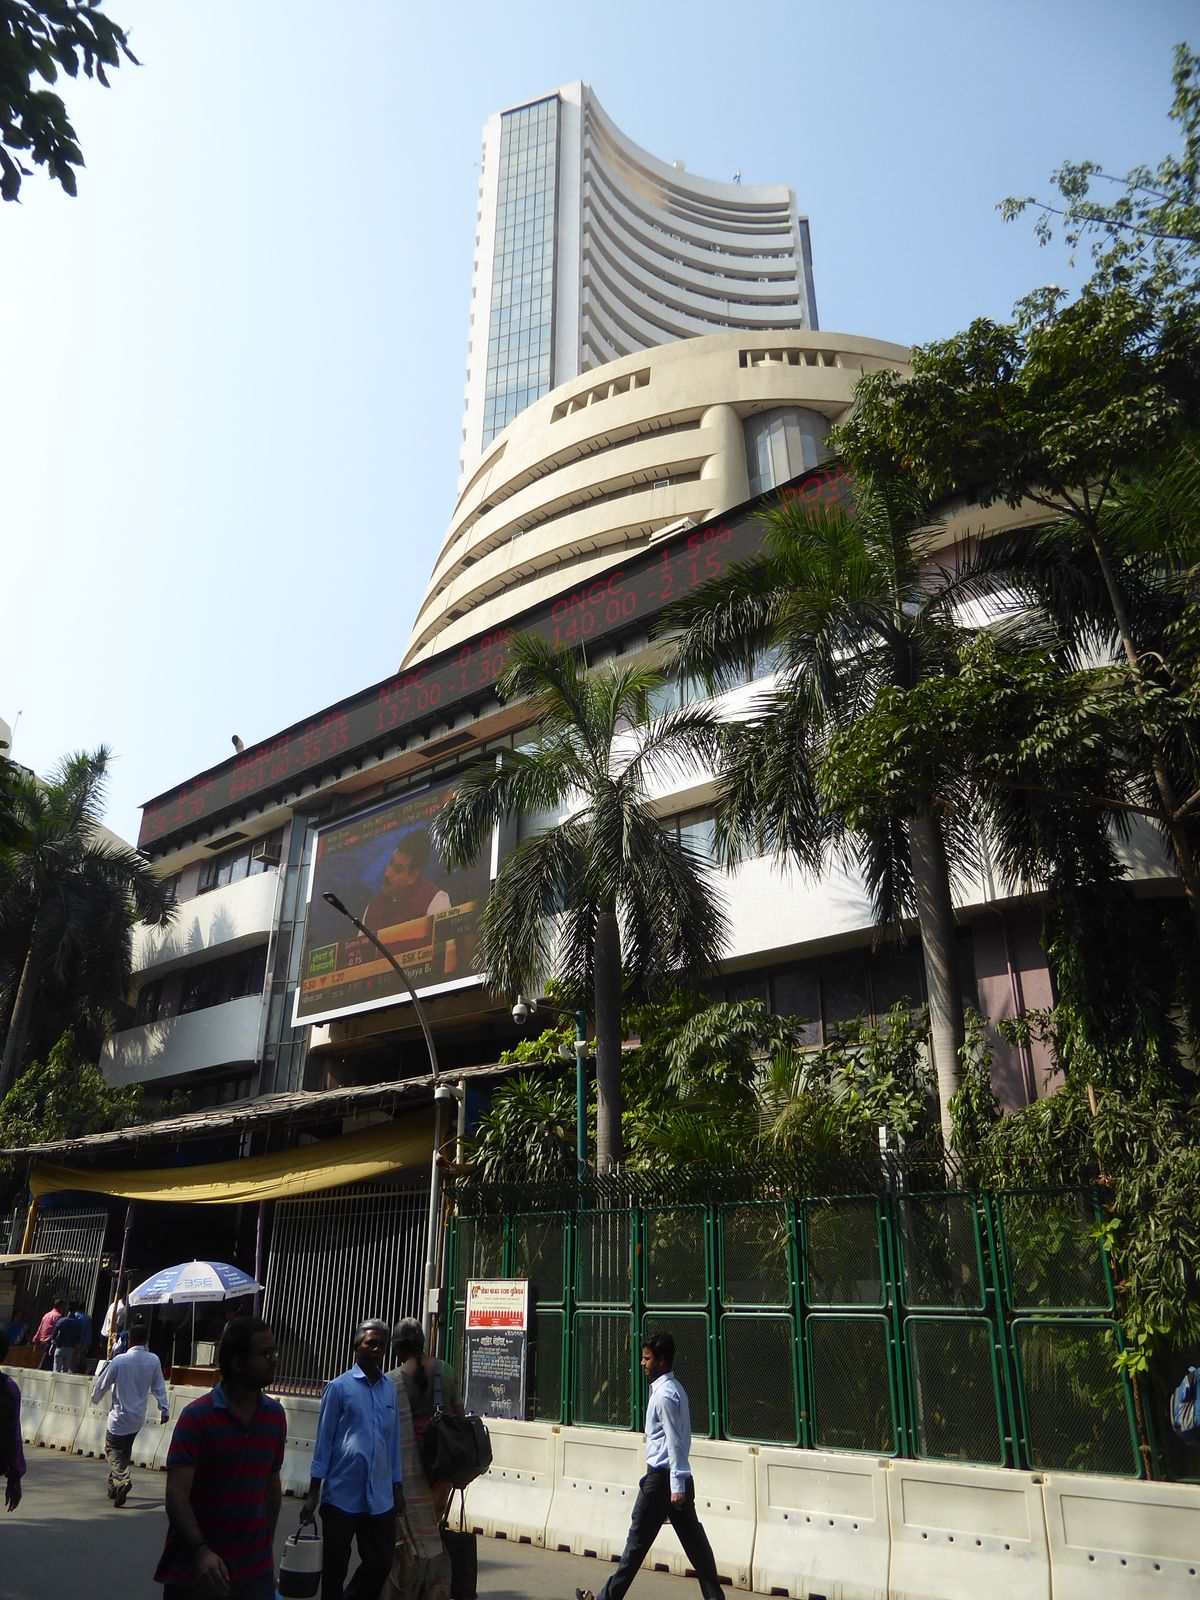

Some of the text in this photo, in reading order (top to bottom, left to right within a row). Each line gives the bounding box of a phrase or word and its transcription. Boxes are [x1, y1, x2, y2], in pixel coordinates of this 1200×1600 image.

[551, 522, 732, 623] ONGC -1.5%
[552, 552, 721, 650] 140.00 -2.15
[375, 654, 505, 731] 137.00 -1.30
[377, 667, 430, 707] NTPC
[185, 1277, 212, 1286] BSE
